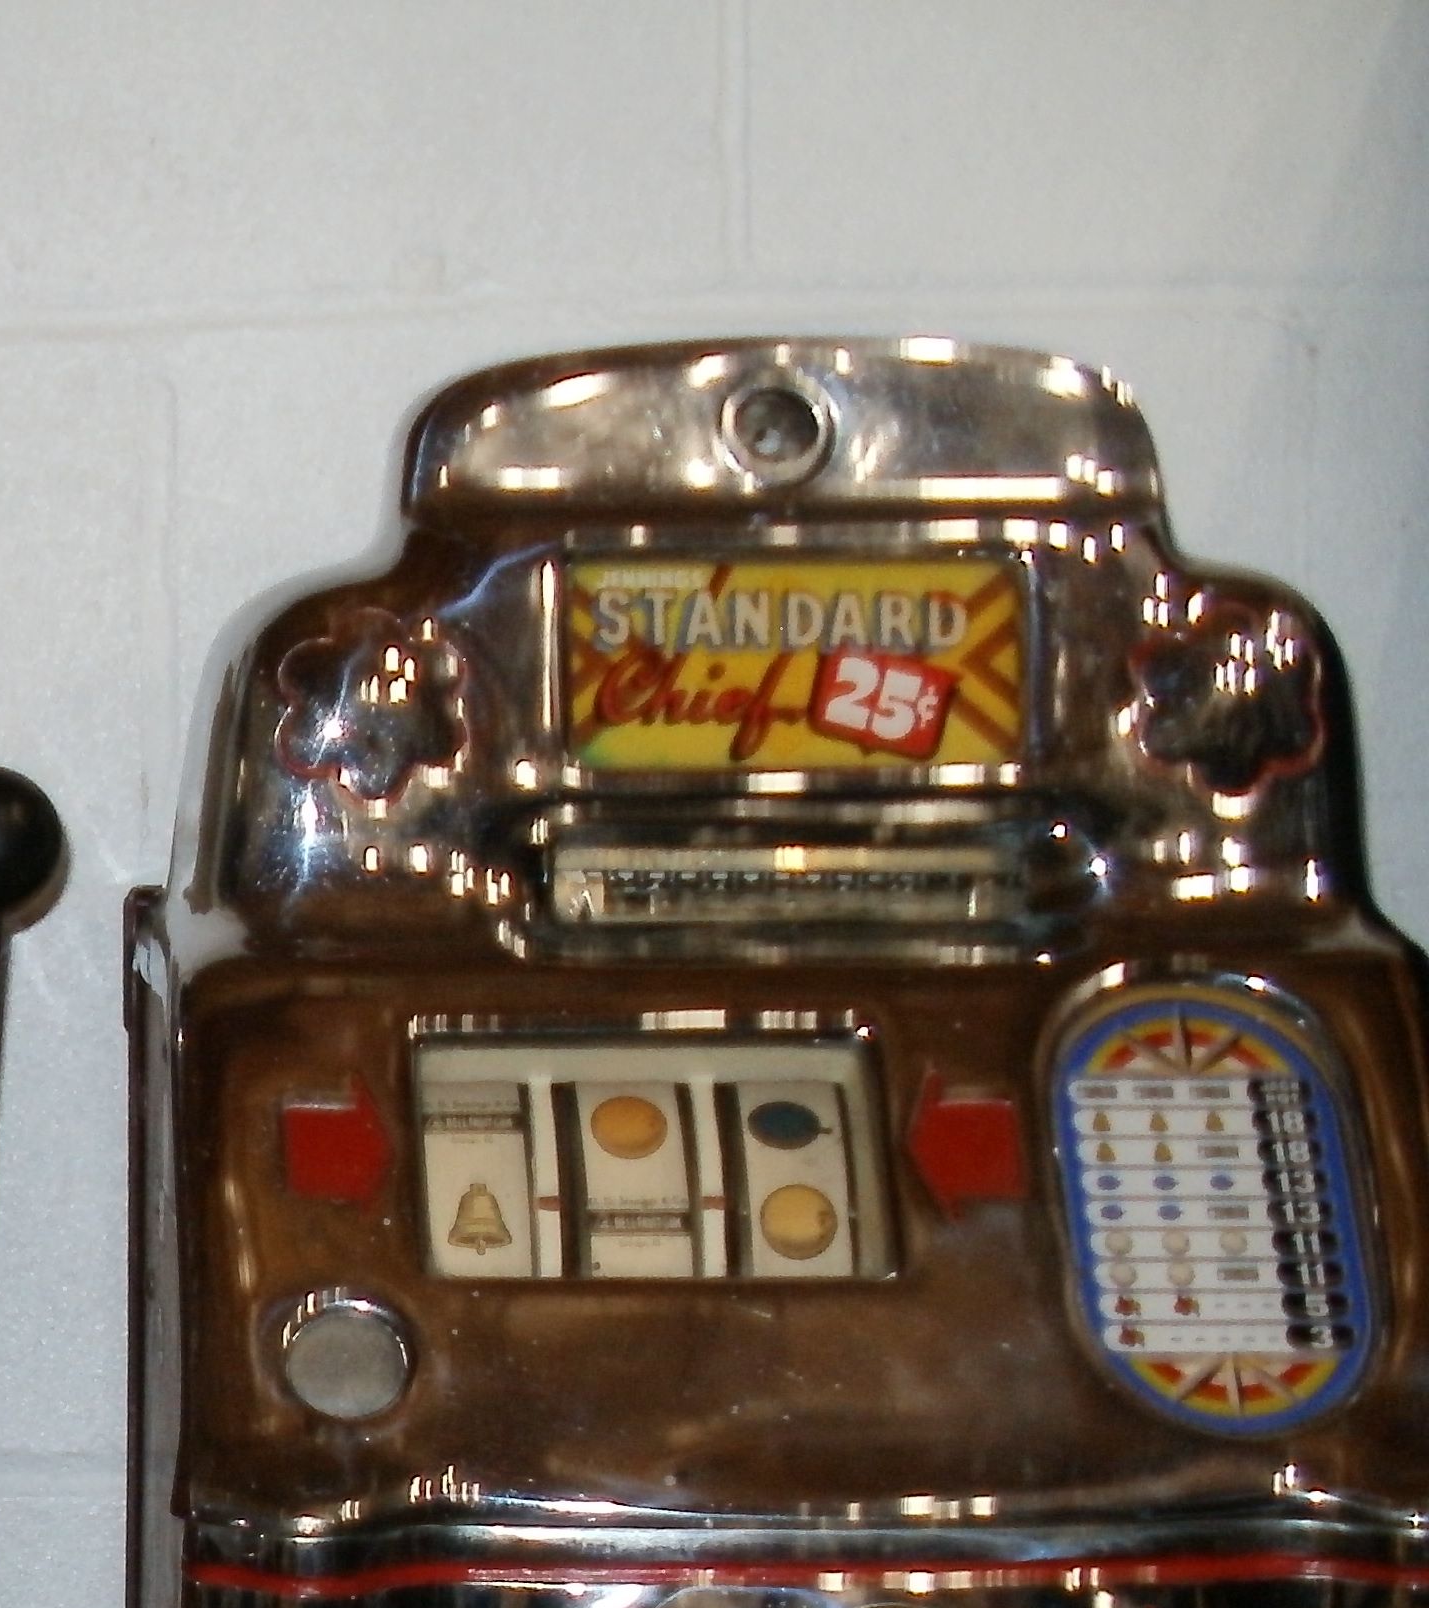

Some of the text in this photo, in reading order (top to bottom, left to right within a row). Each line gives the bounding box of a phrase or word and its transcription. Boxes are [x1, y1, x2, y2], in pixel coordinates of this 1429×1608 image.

[596, 590, 967, 651] STANDARD
[596, 650, 810, 761] Chief
[824, 654, 939, 740] 25¢
[1269, 1110, 1304, 1132] 18
[1274, 1140, 1309, 1162] 18
[1277, 1171, 1315, 1193] 13
[1282, 1201, 1321, 1223] 13
[1294, 1232, 1319, 1253] 11
[1298, 1263, 1324, 1286] 11
